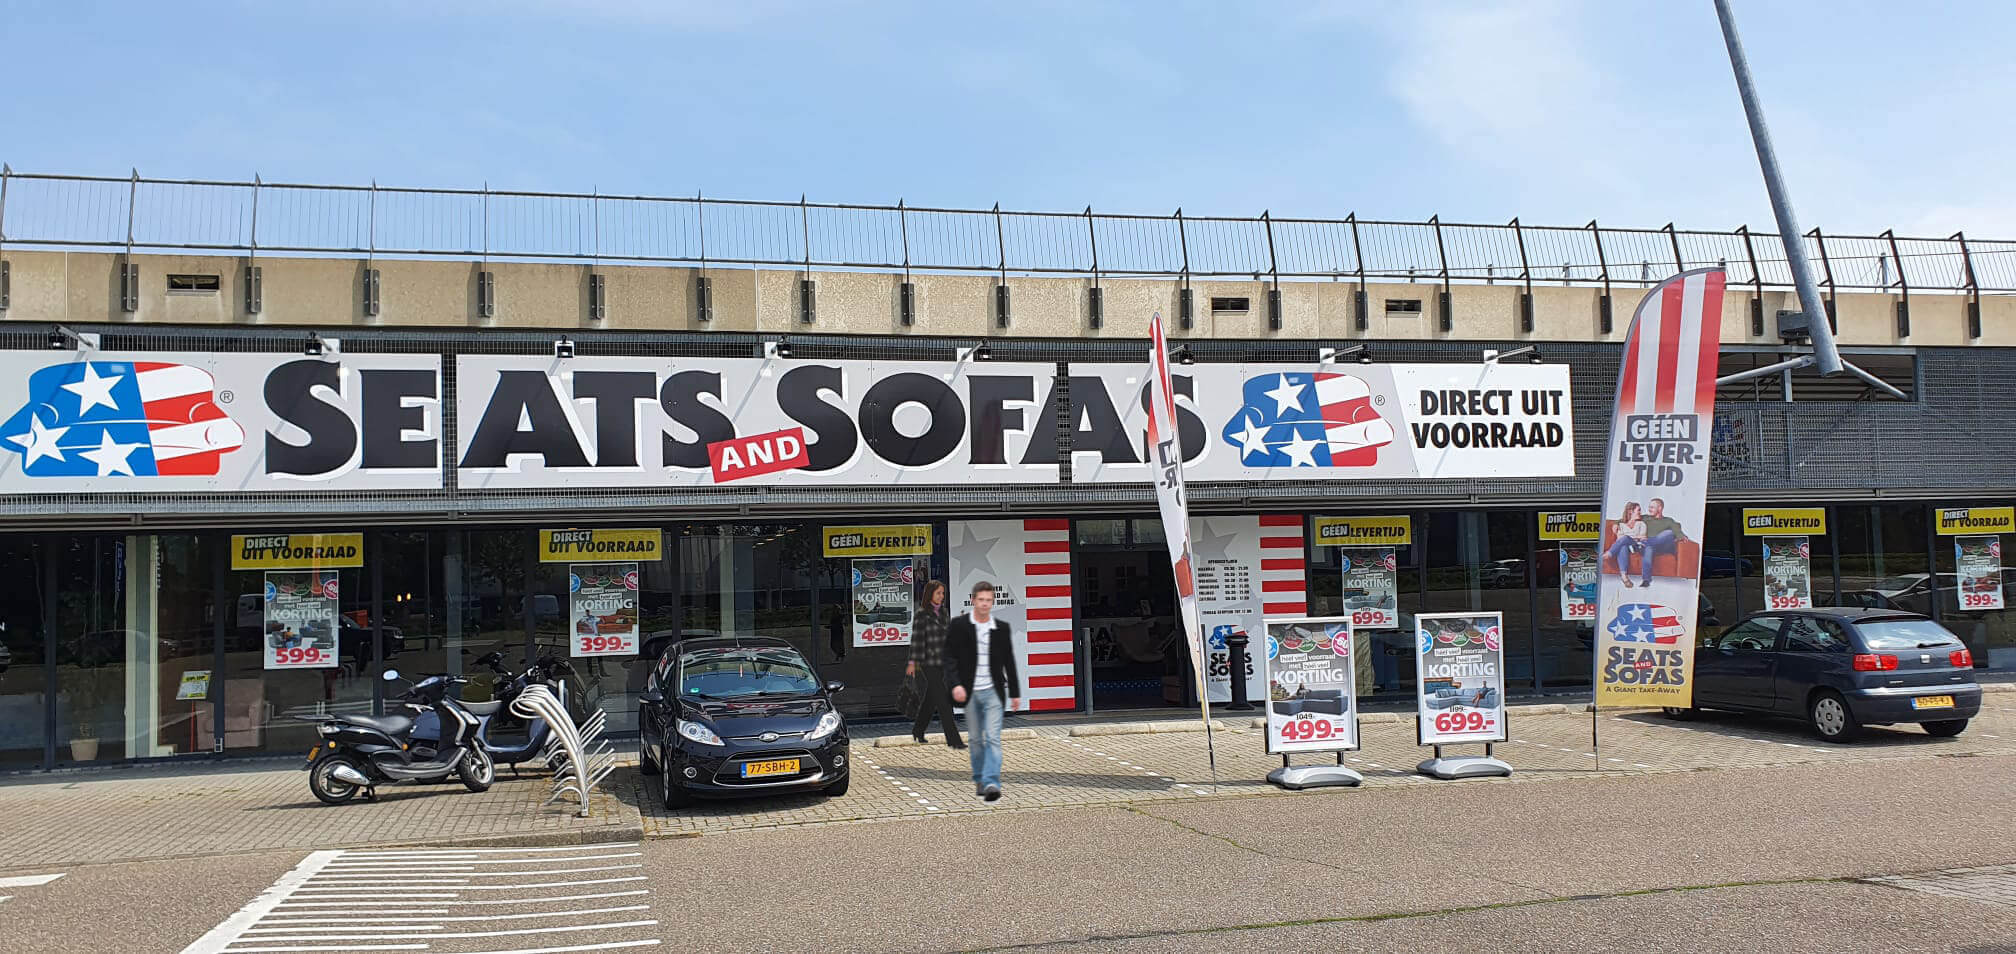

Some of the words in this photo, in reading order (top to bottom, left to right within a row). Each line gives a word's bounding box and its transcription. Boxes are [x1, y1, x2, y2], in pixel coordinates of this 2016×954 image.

[1420, 390, 1512, 416] DIRECT
[1521, 390, 1563, 416] UIT
[263, 359, 736, 477] SEATS
[719, 435, 801, 473] AND
[777, 364, 1207, 472] SOFAS
[1631, 414, 1690, 440] GÉÉN
[1411, 422, 1564, 449] VOORRAAD
[1619, 441, 1703, 464] LEVER-
[1633, 465, 1684, 487] TIJD
[1548, 514, 1576, 523] DIRECT
[1944, 510, 1968, 519] DIRECT
[1545, 523, 1560, 533] UIT
[1565, 523, 1600, 532] VOORR
[1774, 518, 1820, 528] LEVERTIJD
[1960, 517, 2009, 527] VOORRAAD
[553, 531, 592, 543] DIRECT
[1351, 527, 1405, 537] LEVERTIJD
[246, 537, 288, 549] DIRECT
[549, 542, 571, 553] UIT
[577, 541, 655, 552] VOORRAAD
[864, 536, 926, 548] LEVERTIJD
[242, 547, 264, 560] UIT
[272, 546, 357, 560] VOORRAAD
[1565, 571, 1597, 580] KORTIN
[1768, 566, 1806, 575] KORTING
[1347, 579, 1392, 588] KORTING
[857, 592, 909, 603] KORTING
[575, 599, 633, 611] KORTING
[271, 608, 333, 620] KORTING
[1210, 652, 1252, 664] SES
[1608, 646, 1683, 666] SEATS
[1209, 664, 1254, 676] SOS
[1428, 663, 1495, 677] KORTING
[1635, 661, 1651, 669] AND
[1274, 669, 1344, 683] KORTING
[1604, 662, 1685, 686] SOFAS
[1435, 711, 1495, 732] 699.-
[1281, 719, 1344, 740] 499.-
[750, 761, 795, 773] 77-SBH-2
